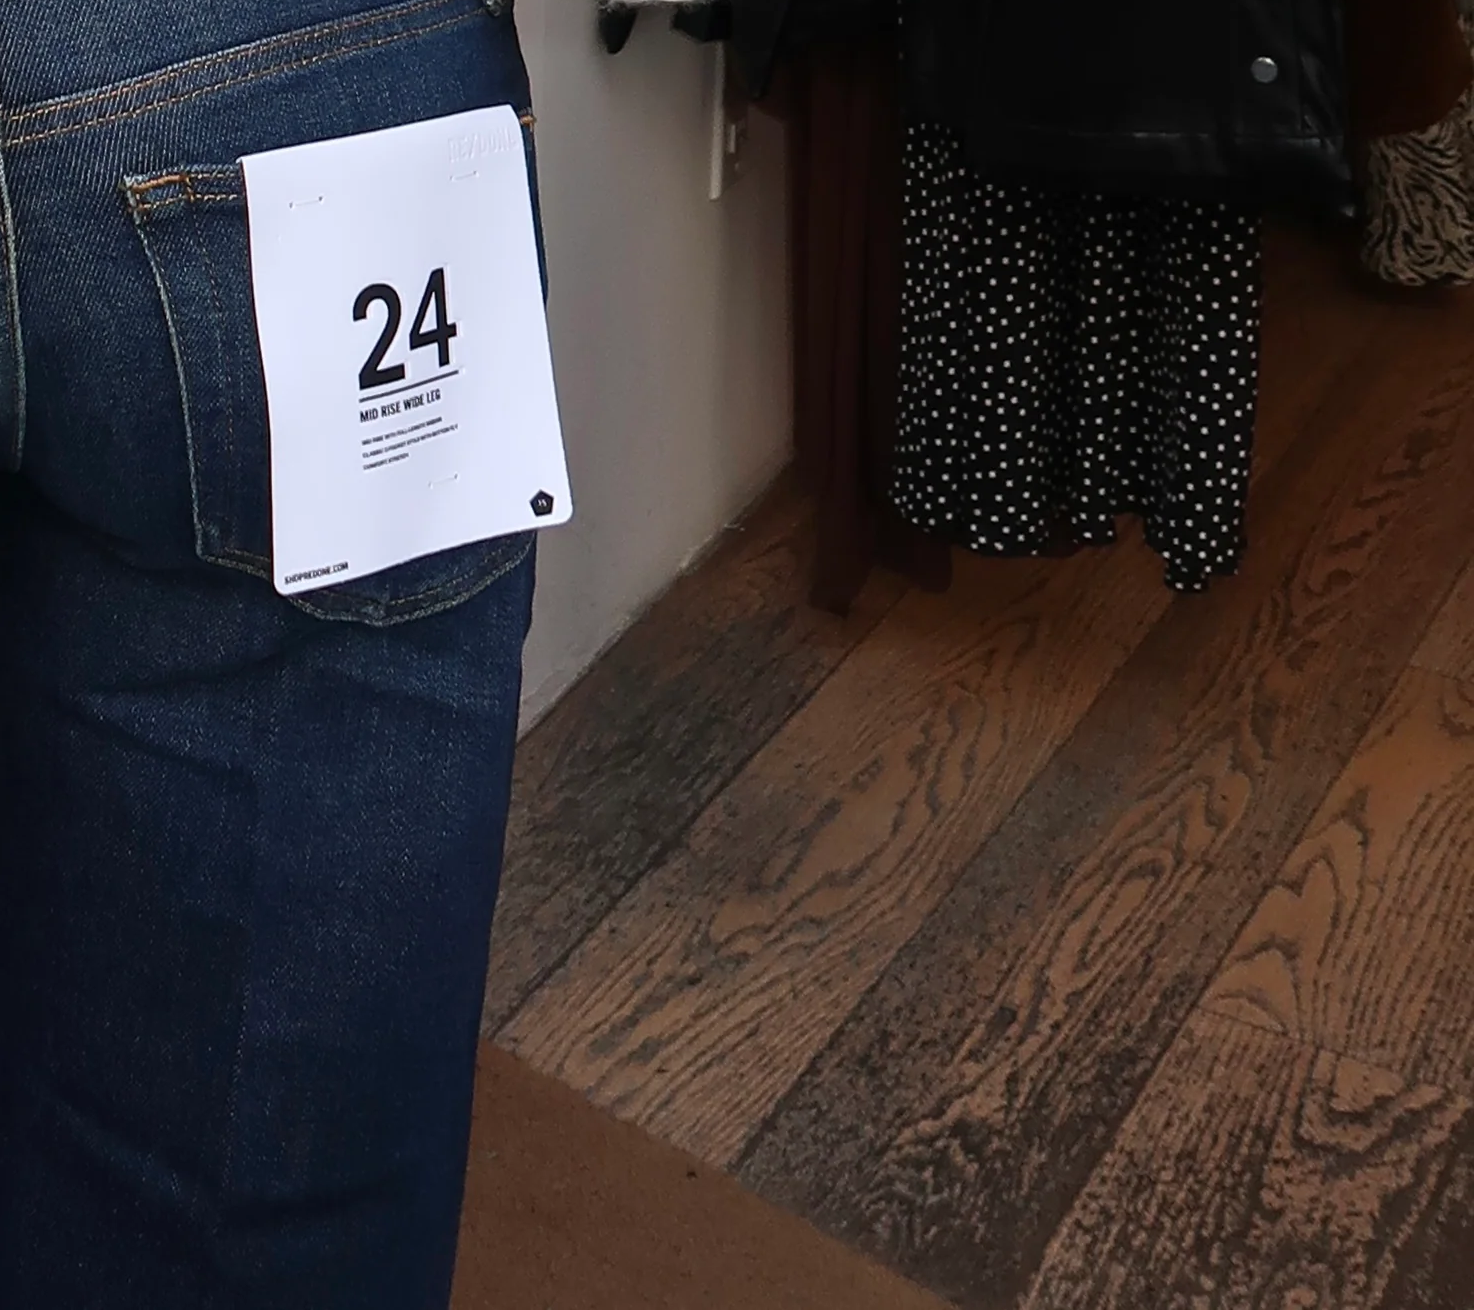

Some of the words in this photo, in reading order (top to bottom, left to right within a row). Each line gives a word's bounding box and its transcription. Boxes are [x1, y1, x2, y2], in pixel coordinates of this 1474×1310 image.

[352, 267, 458, 390] 24
[360, 408, 379, 423] MID
[381, 401, 401, 418] RISE
[403, 393, 424, 411] WIDE
[426, 388, 441, 404] LEG
